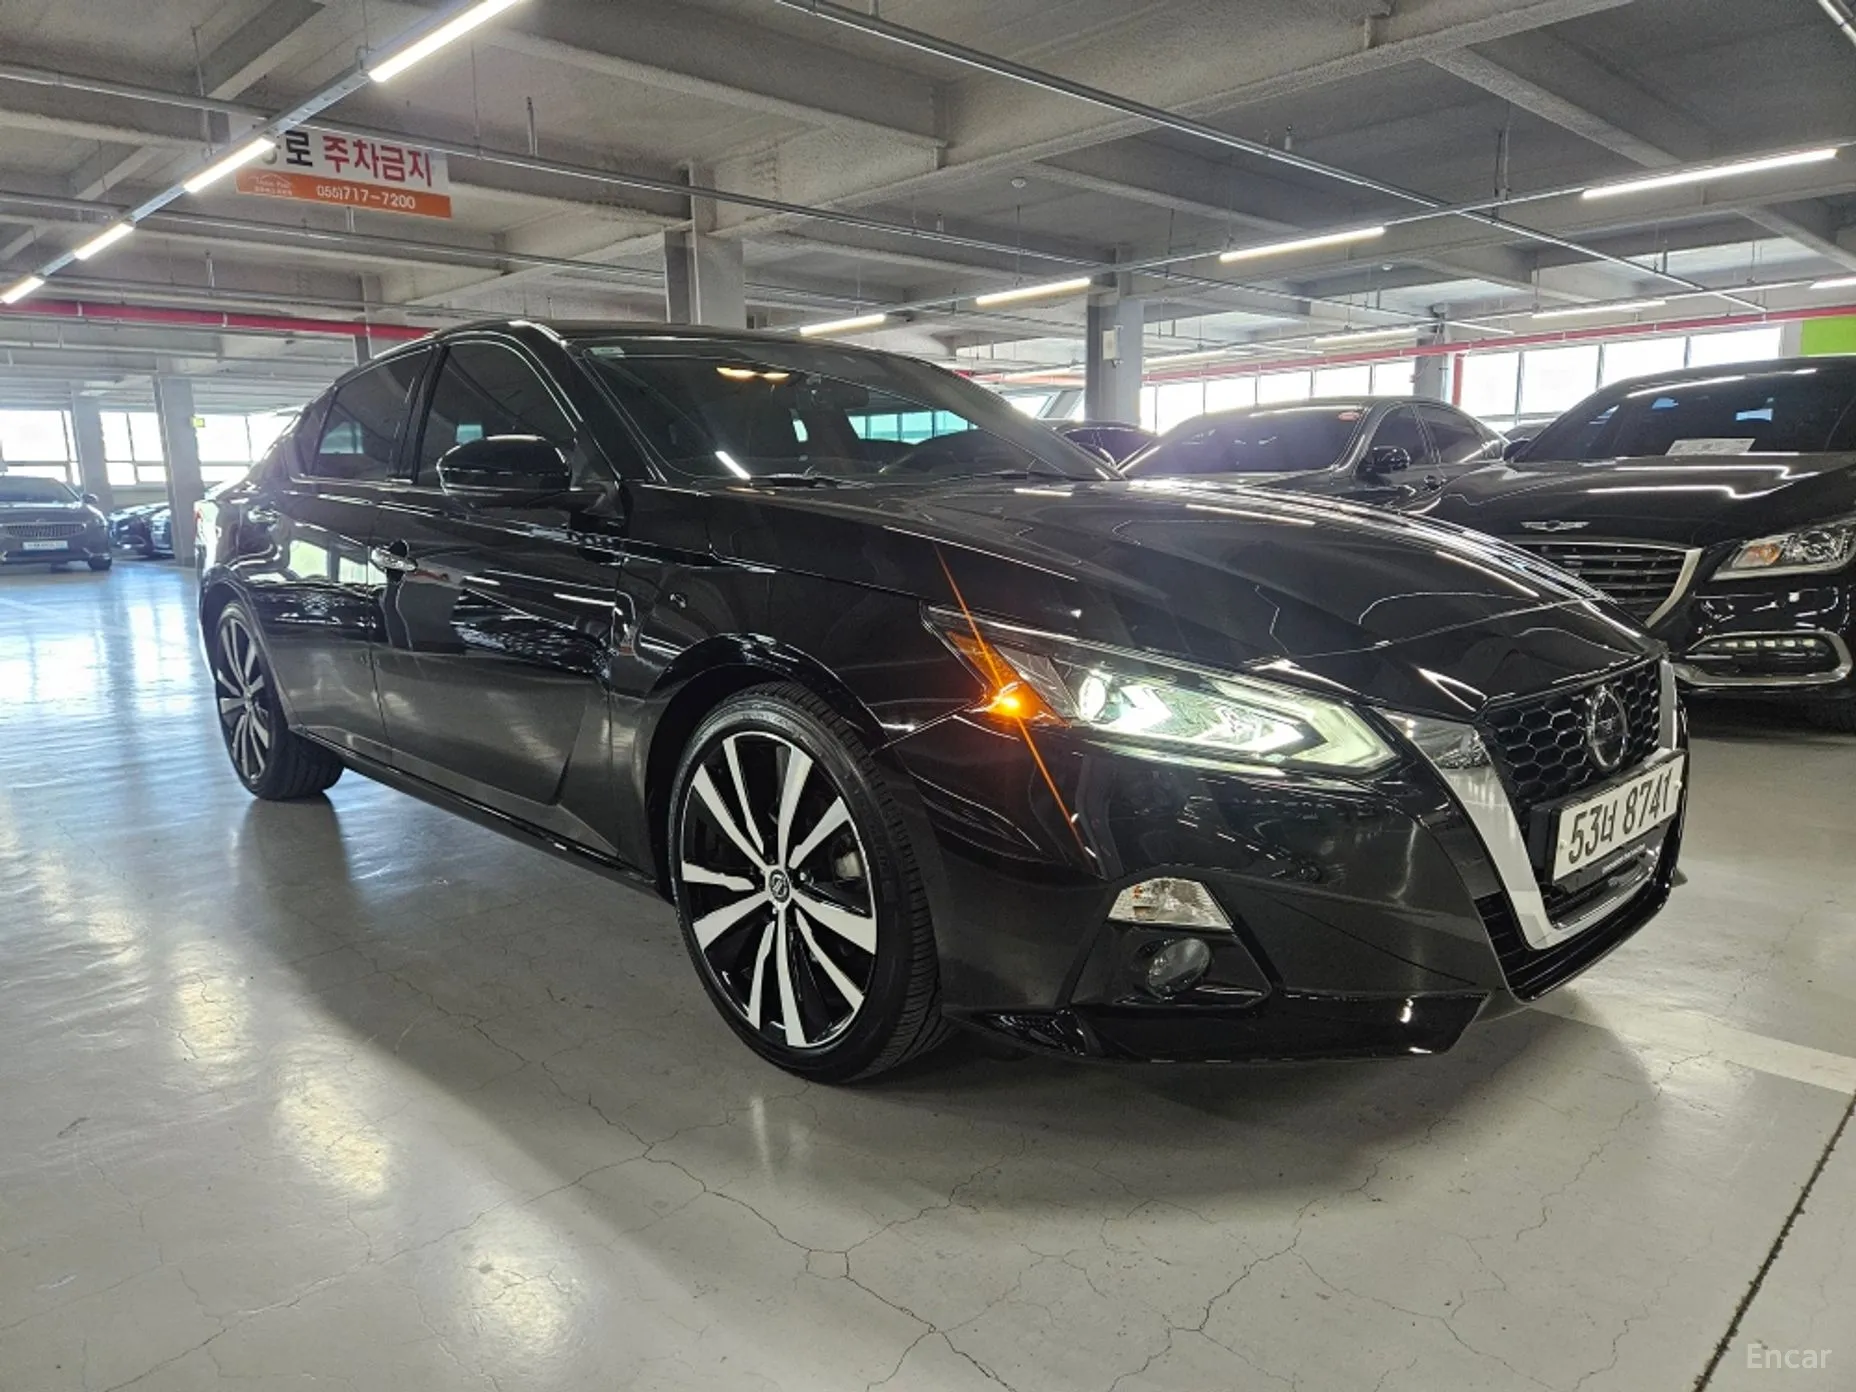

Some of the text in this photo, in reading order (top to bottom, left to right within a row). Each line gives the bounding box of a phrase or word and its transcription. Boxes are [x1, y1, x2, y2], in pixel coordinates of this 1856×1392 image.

[322, 135, 432, 187] 주차금지
[1568, 766, 1674, 864] 53너 8741
